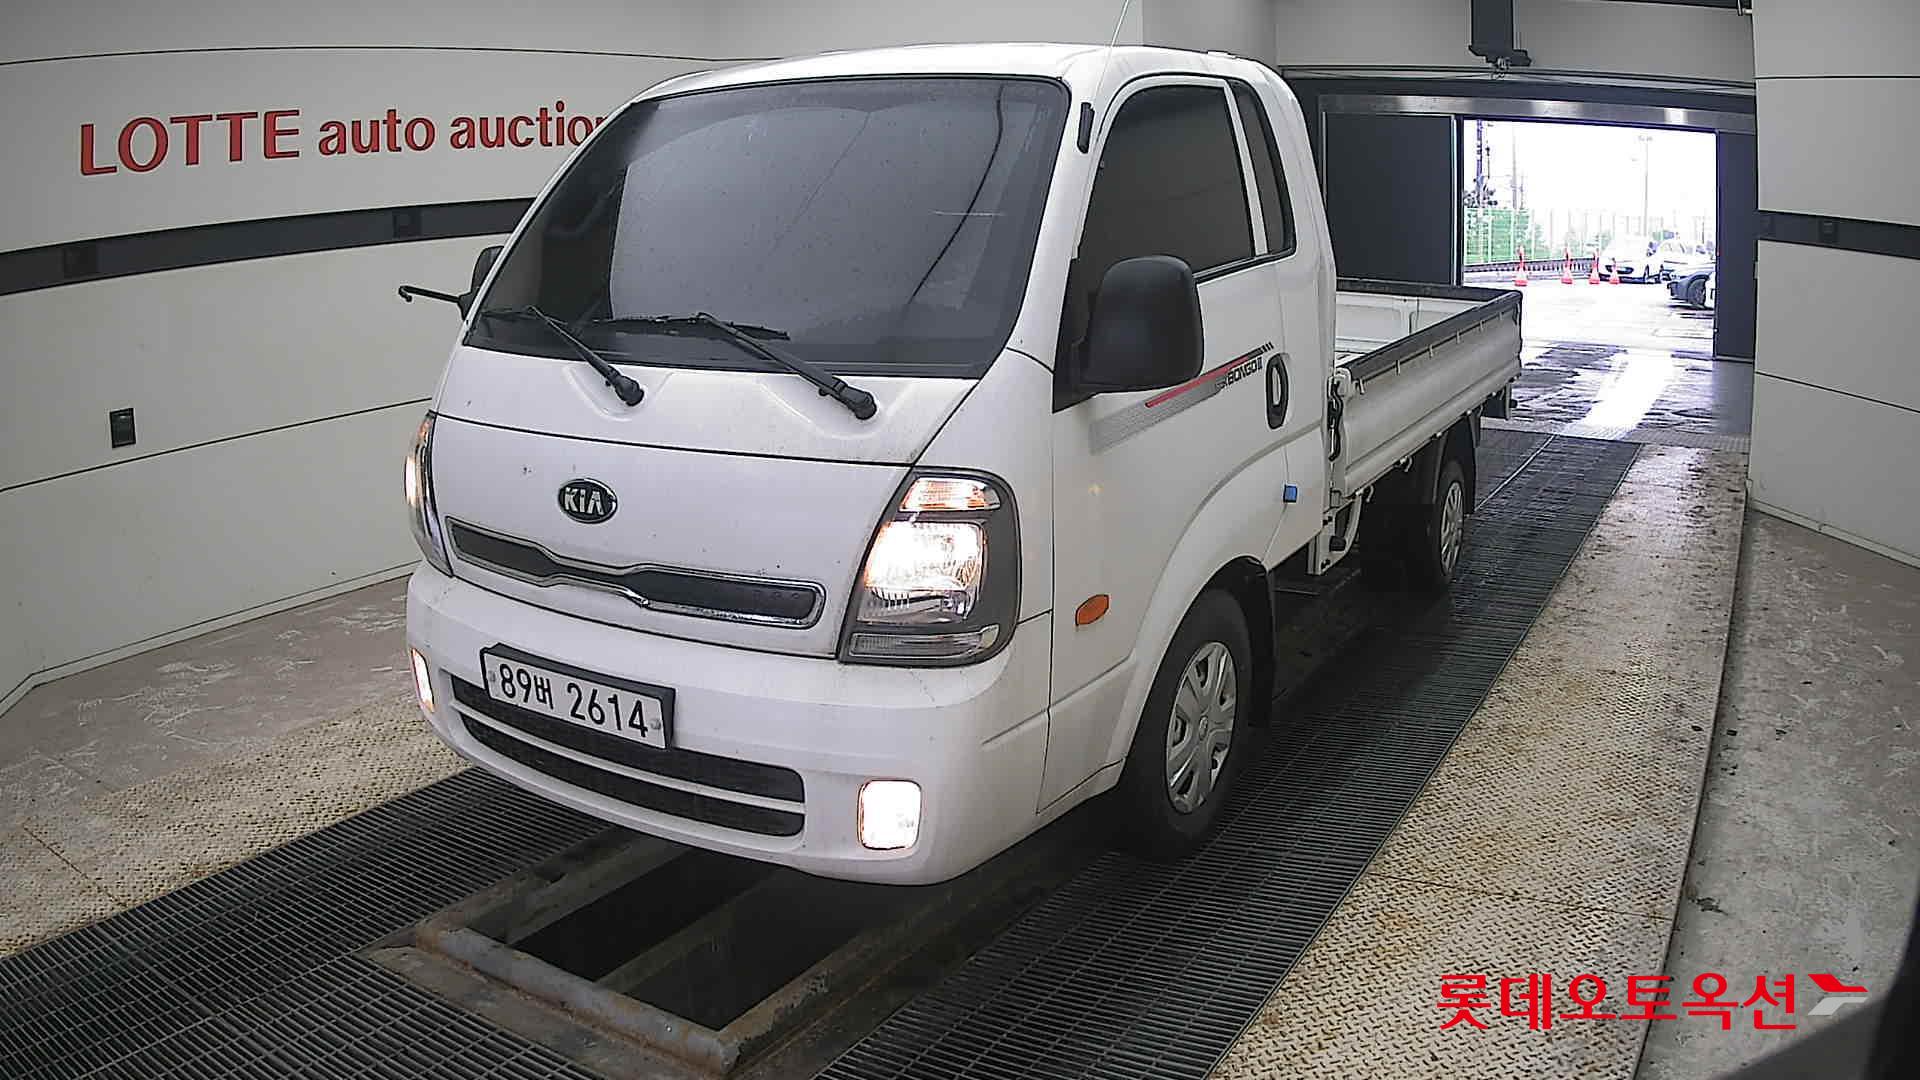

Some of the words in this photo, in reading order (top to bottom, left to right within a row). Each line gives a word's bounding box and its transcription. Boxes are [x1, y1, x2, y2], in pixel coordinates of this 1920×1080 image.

[79, 109, 301, 177] LOTTE
[318, 108, 436, 157] auto
[449, 100, 607, 150] auctio
[564, 486, 604, 516] KIA
[500, 664, 554, 710] 89버
[567, 682, 648, 738] 2614
